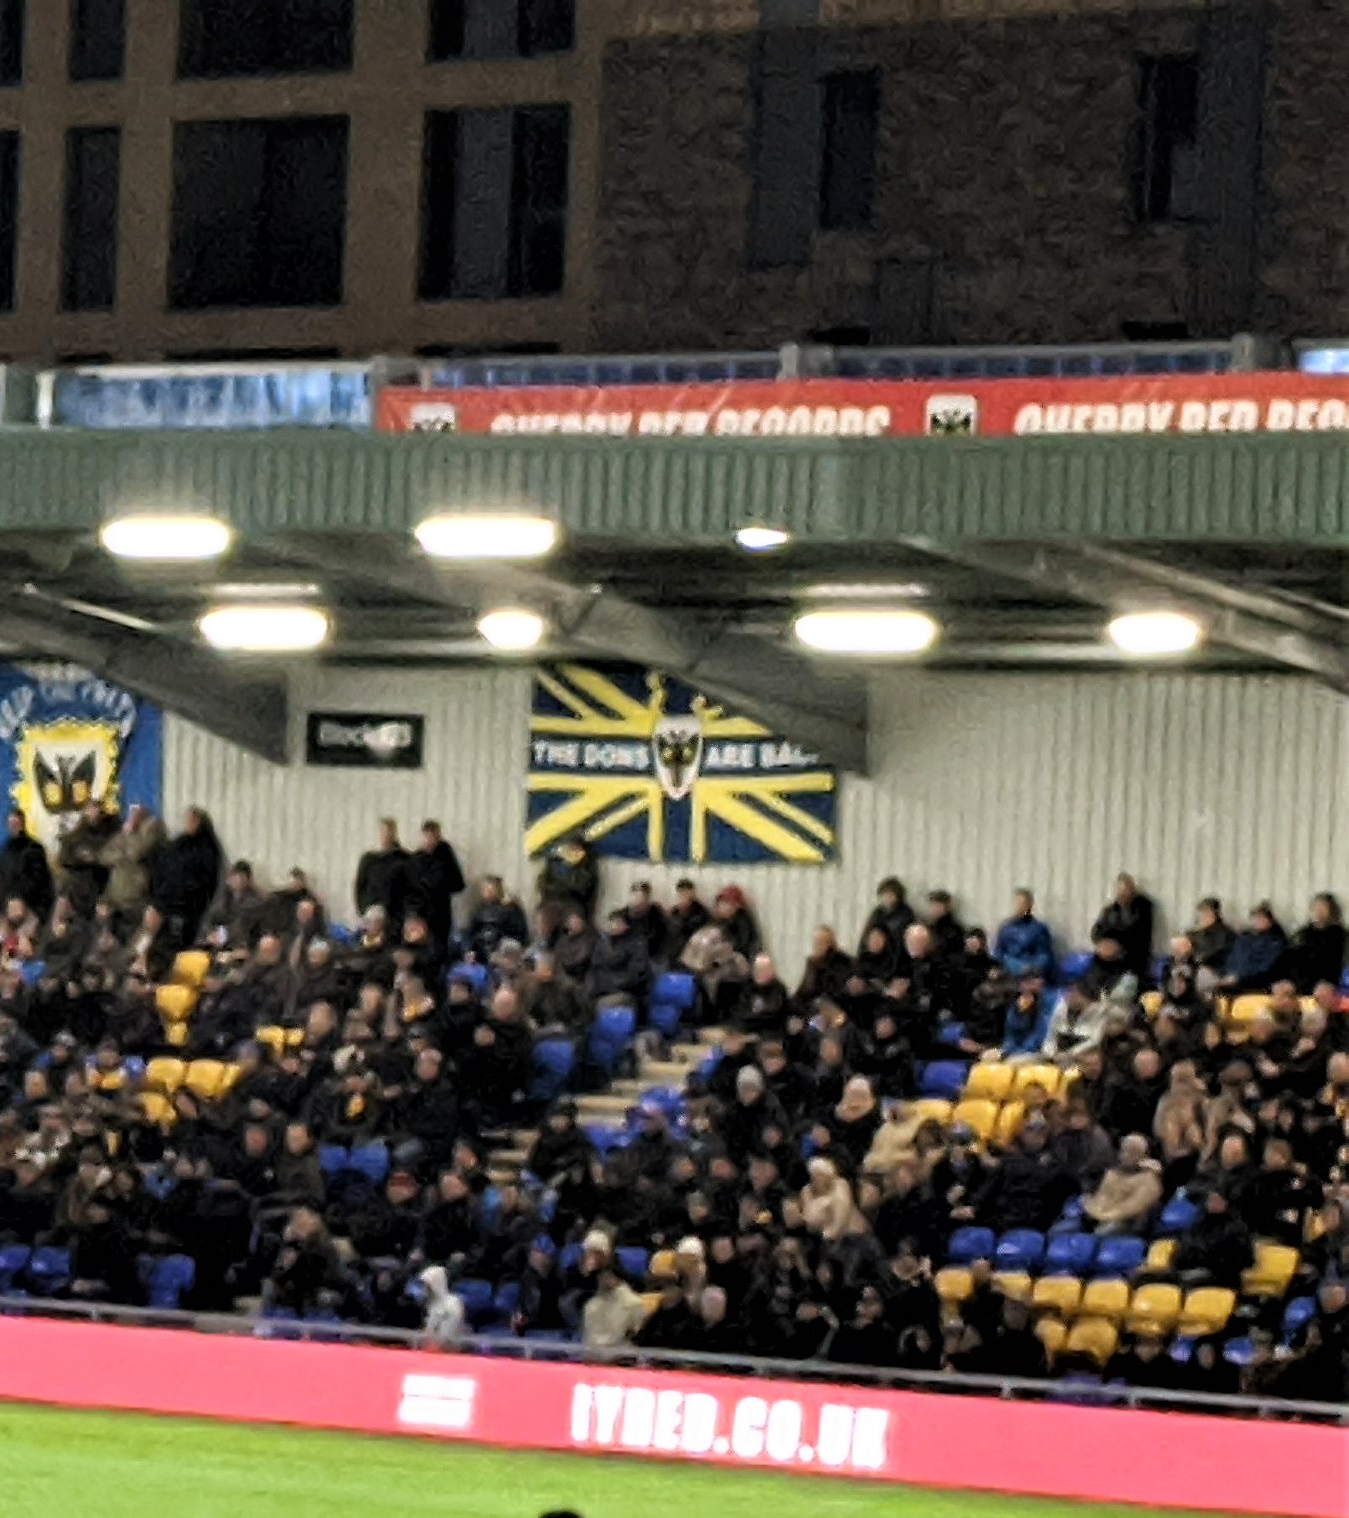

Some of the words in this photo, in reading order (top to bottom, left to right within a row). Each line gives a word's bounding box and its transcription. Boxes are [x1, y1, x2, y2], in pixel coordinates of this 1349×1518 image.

[532, 740, 580, 768] THE
[583, 741, 649, 769] DONS
[703, 742, 754, 769] ARE
